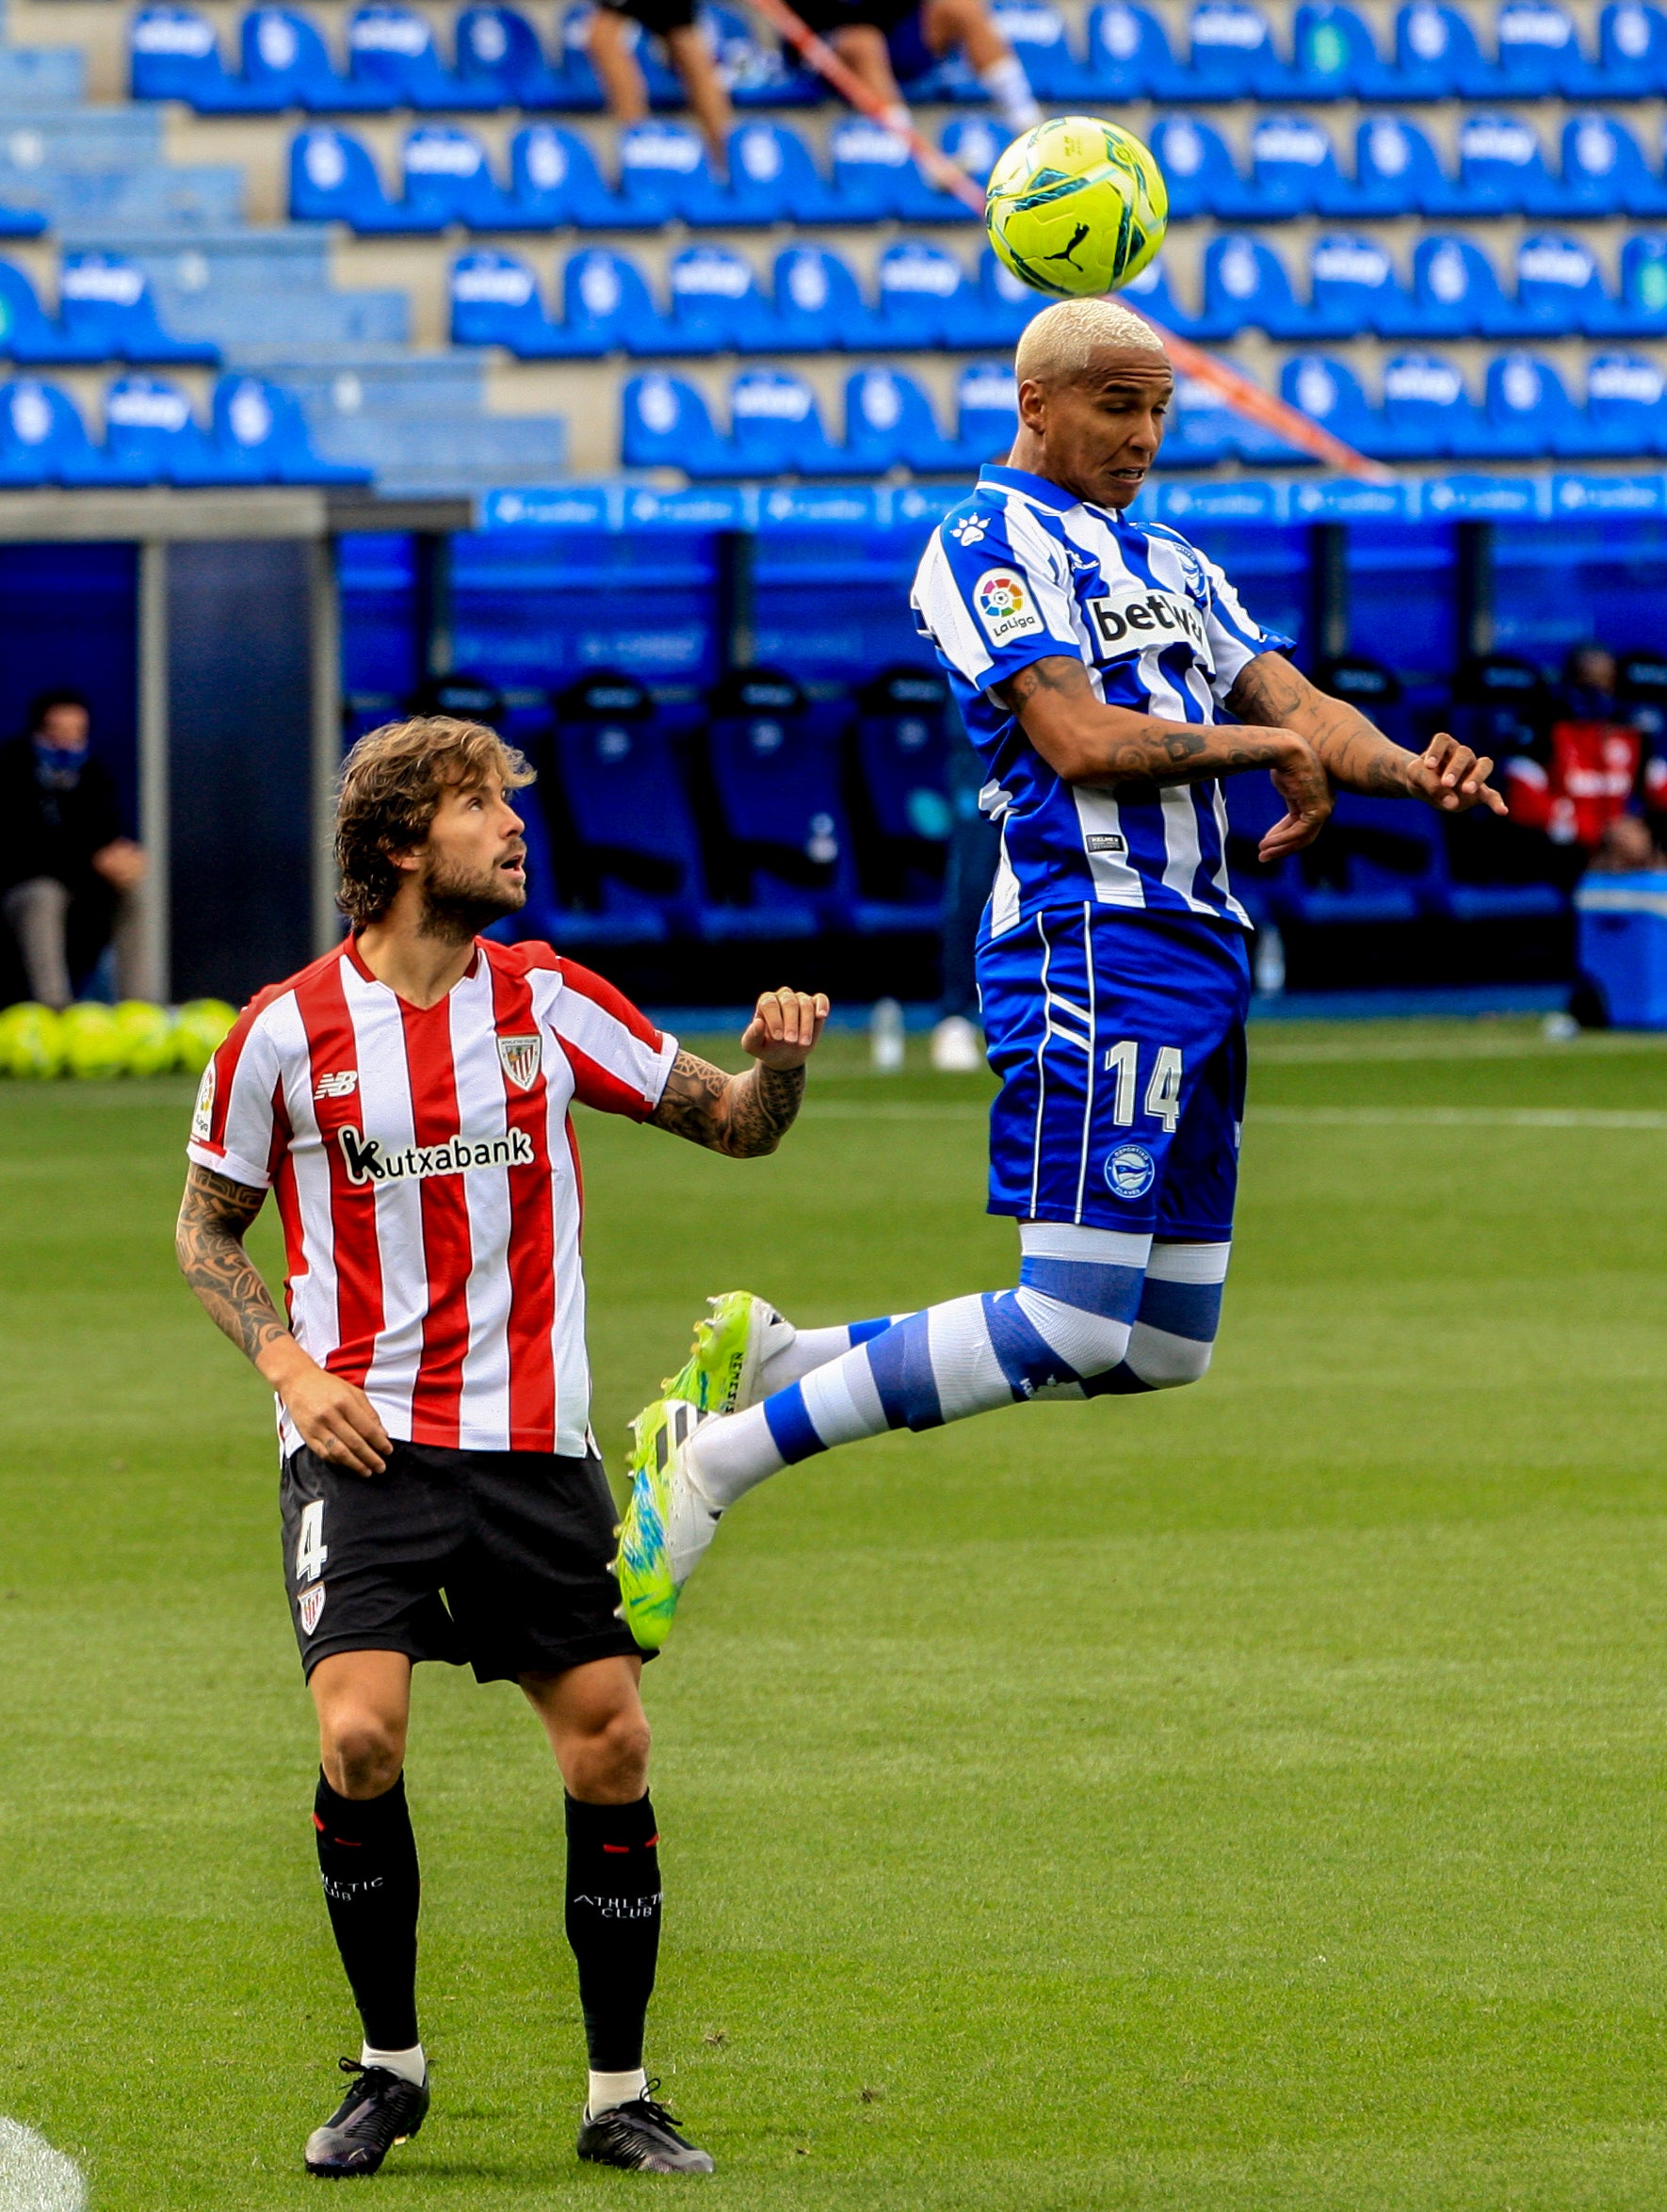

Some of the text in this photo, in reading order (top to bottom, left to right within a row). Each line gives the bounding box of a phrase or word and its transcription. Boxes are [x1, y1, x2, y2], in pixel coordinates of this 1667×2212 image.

[994, 615, 1036, 638] LaLiga
[1104, 1041, 1183, 1133] 14
[343, 1129, 530, 1179] Kutxabank
[296, 1499, 328, 1582] 4
[601, 1907, 653, 1918] CLUB
